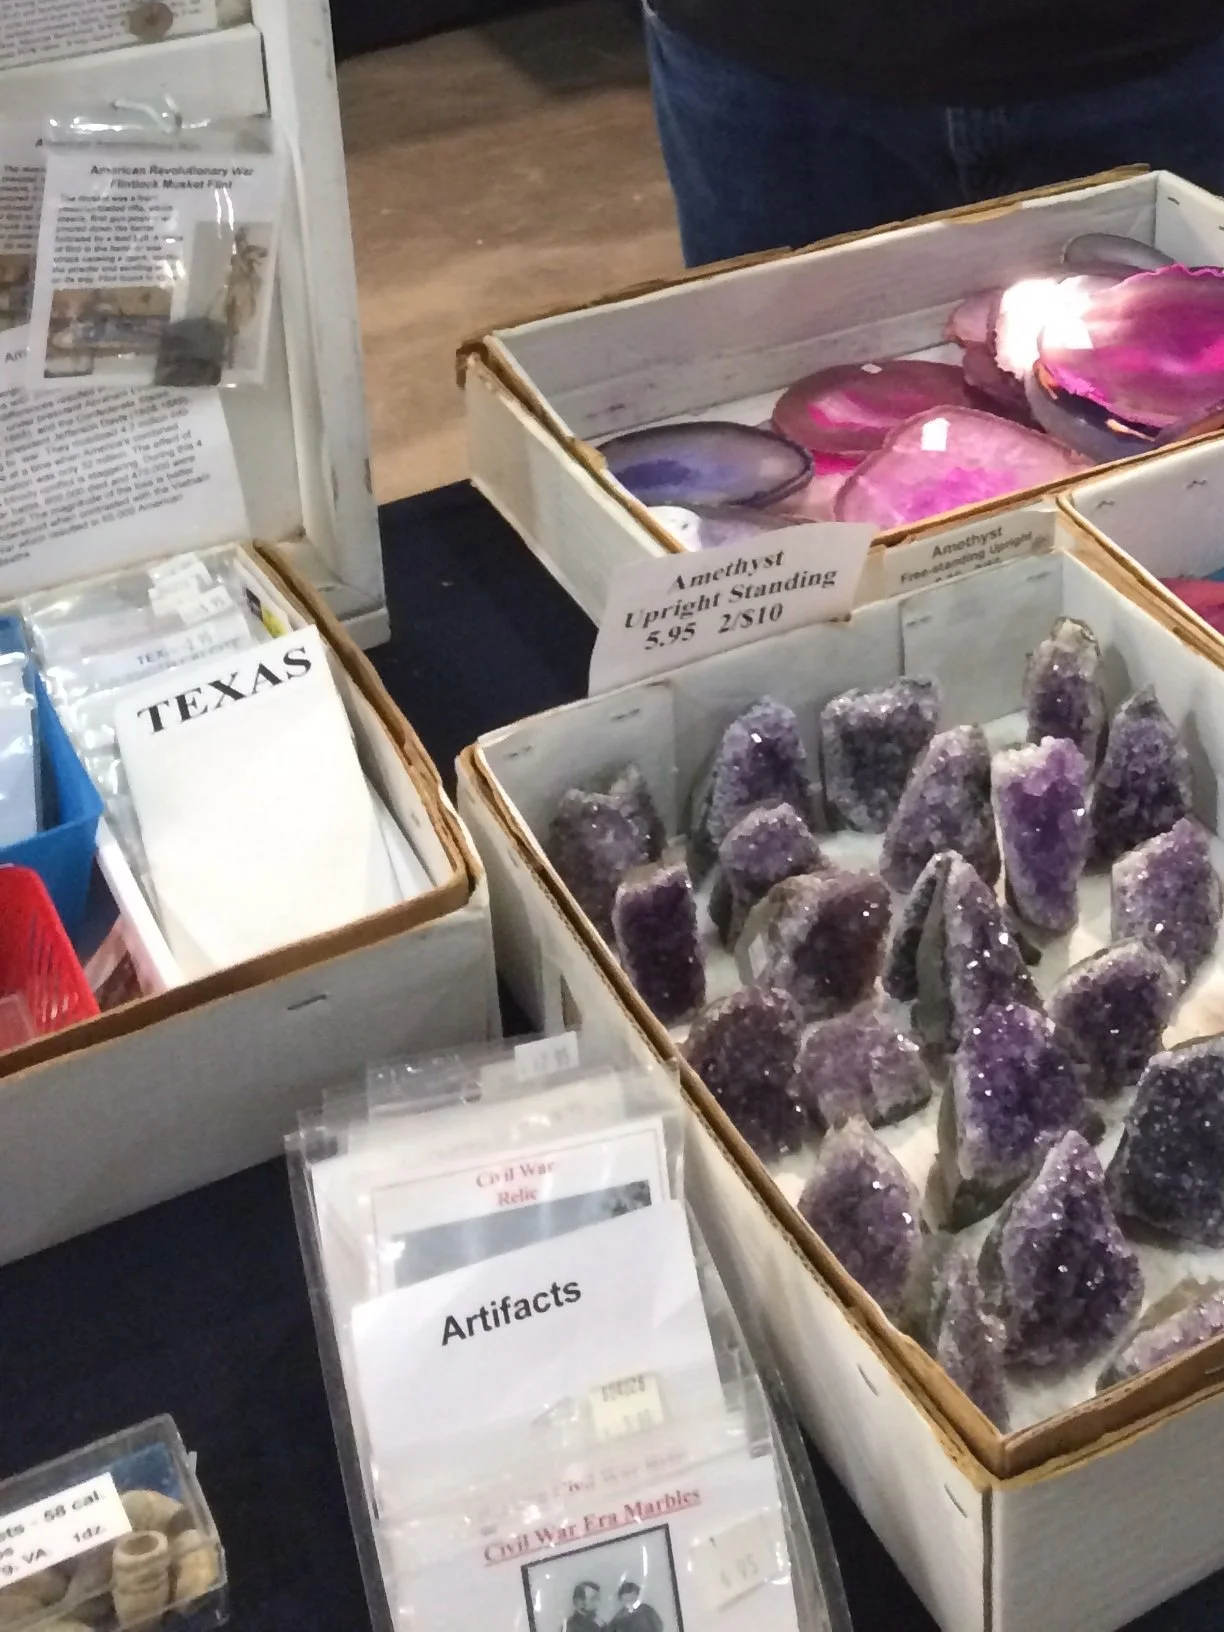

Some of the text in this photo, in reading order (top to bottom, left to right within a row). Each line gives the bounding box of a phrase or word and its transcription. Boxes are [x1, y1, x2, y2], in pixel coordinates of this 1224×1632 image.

[91, 166, 254, 177] American Revolutionary War
[163, 180, 204, 189] Musket
[932, 526, 1003, 559] Amethyst
[668, 549, 784, 595] Amethyst
[901, 550, 985, 584] Free-standing
[624, 570, 837, 629] Upright Standing
[644, 602, 784, 650] 5.95 2/$10
[137, 646, 313, 734] TEXAS
[476, 1160, 555, 1188] Civil War
[497, 1189, 537, 1206] Relic
[441, 1279, 582, 1347] Artifacts
[484, 1488, 701, 1563] Civil War Era Marbles
[22, 1548, 47, 1563] VA
